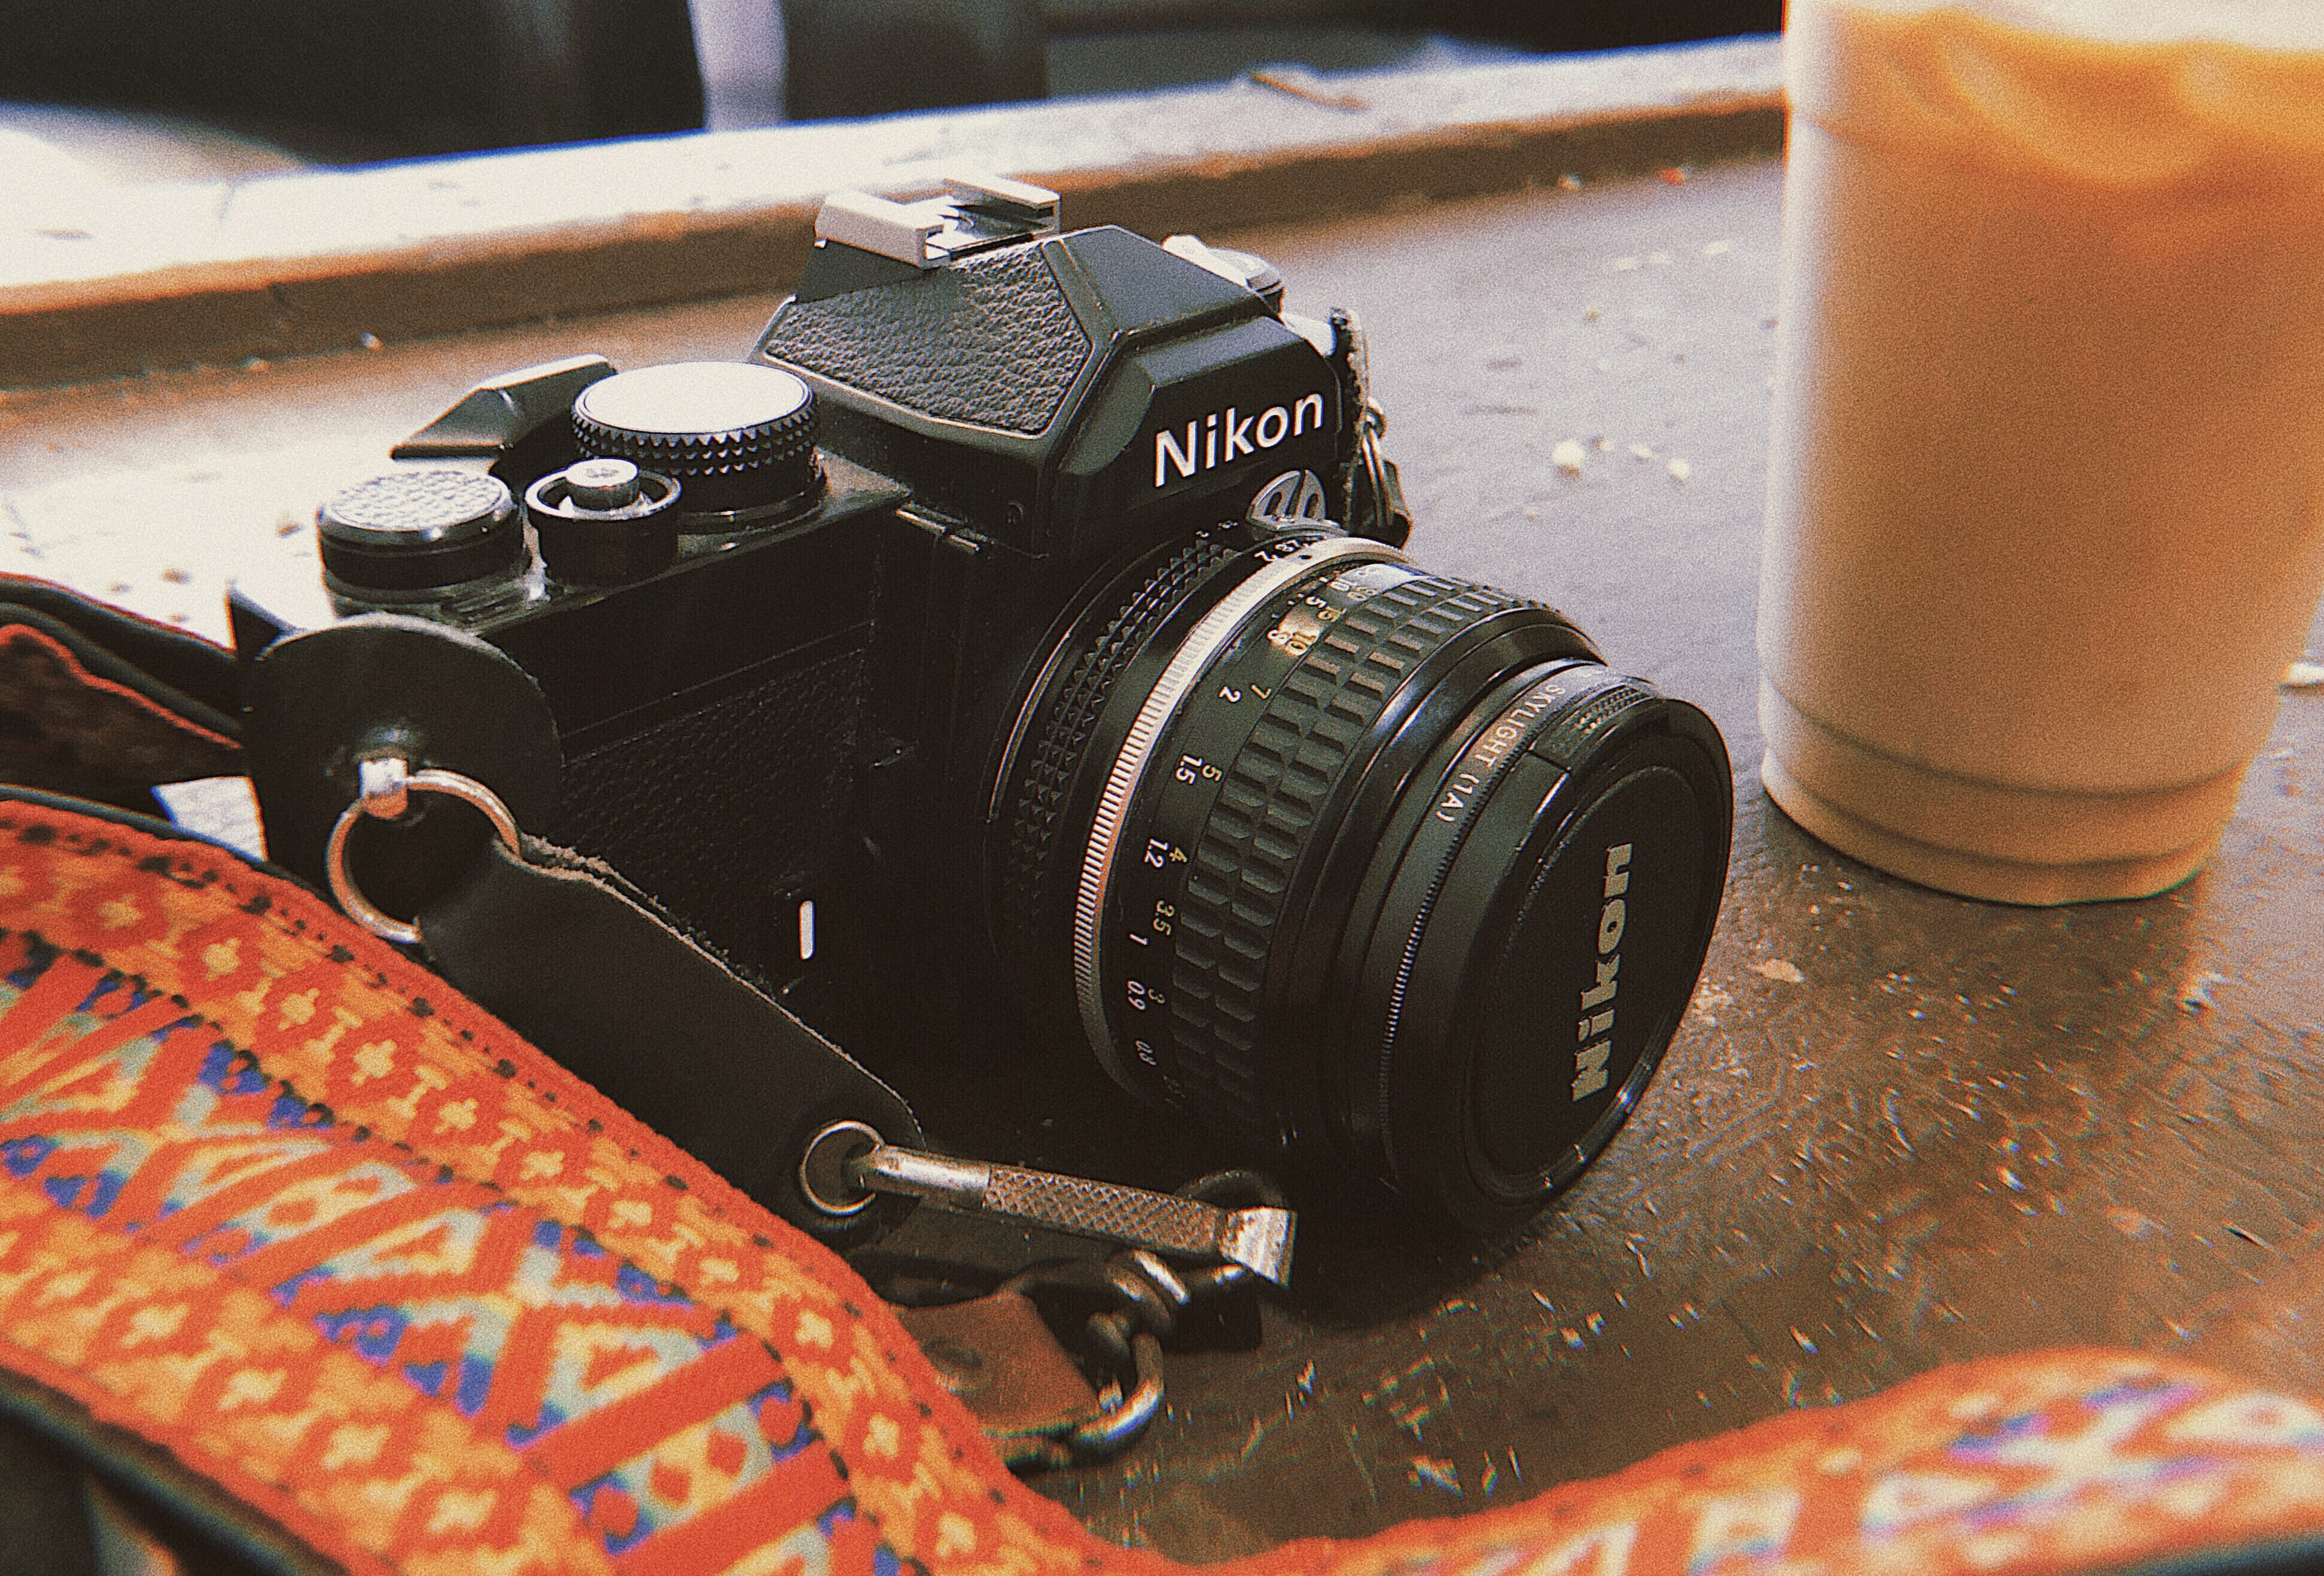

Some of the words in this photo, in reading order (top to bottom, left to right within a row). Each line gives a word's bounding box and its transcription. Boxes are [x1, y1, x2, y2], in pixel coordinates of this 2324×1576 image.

[1155, 393, 1324, 488] Nikon
[1305, 596, 1328, 609] 5
[1218, 685, 1242, 704] 2
[1251, 683, 1272, 700] 7
[1474, 684, 1566, 768] SKYLIGHT
[1174, 753, 1204, 786] 1.5
[1200, 764, 1223, 782] 5
[1435, 772, 1480, 823] (1A)
[1144, 838, 1170, 868] 1.2
[1168, 847, 1189, 863] 4
[1152, 900, 1175, 936] 3.5
[1128, 933, 1149, 947] 1
[1570, 842, 1634, 1102] Nikon
[1126, 979, 1147, 1011] 0.9
[1147, 987, 1166, 1005] 3
